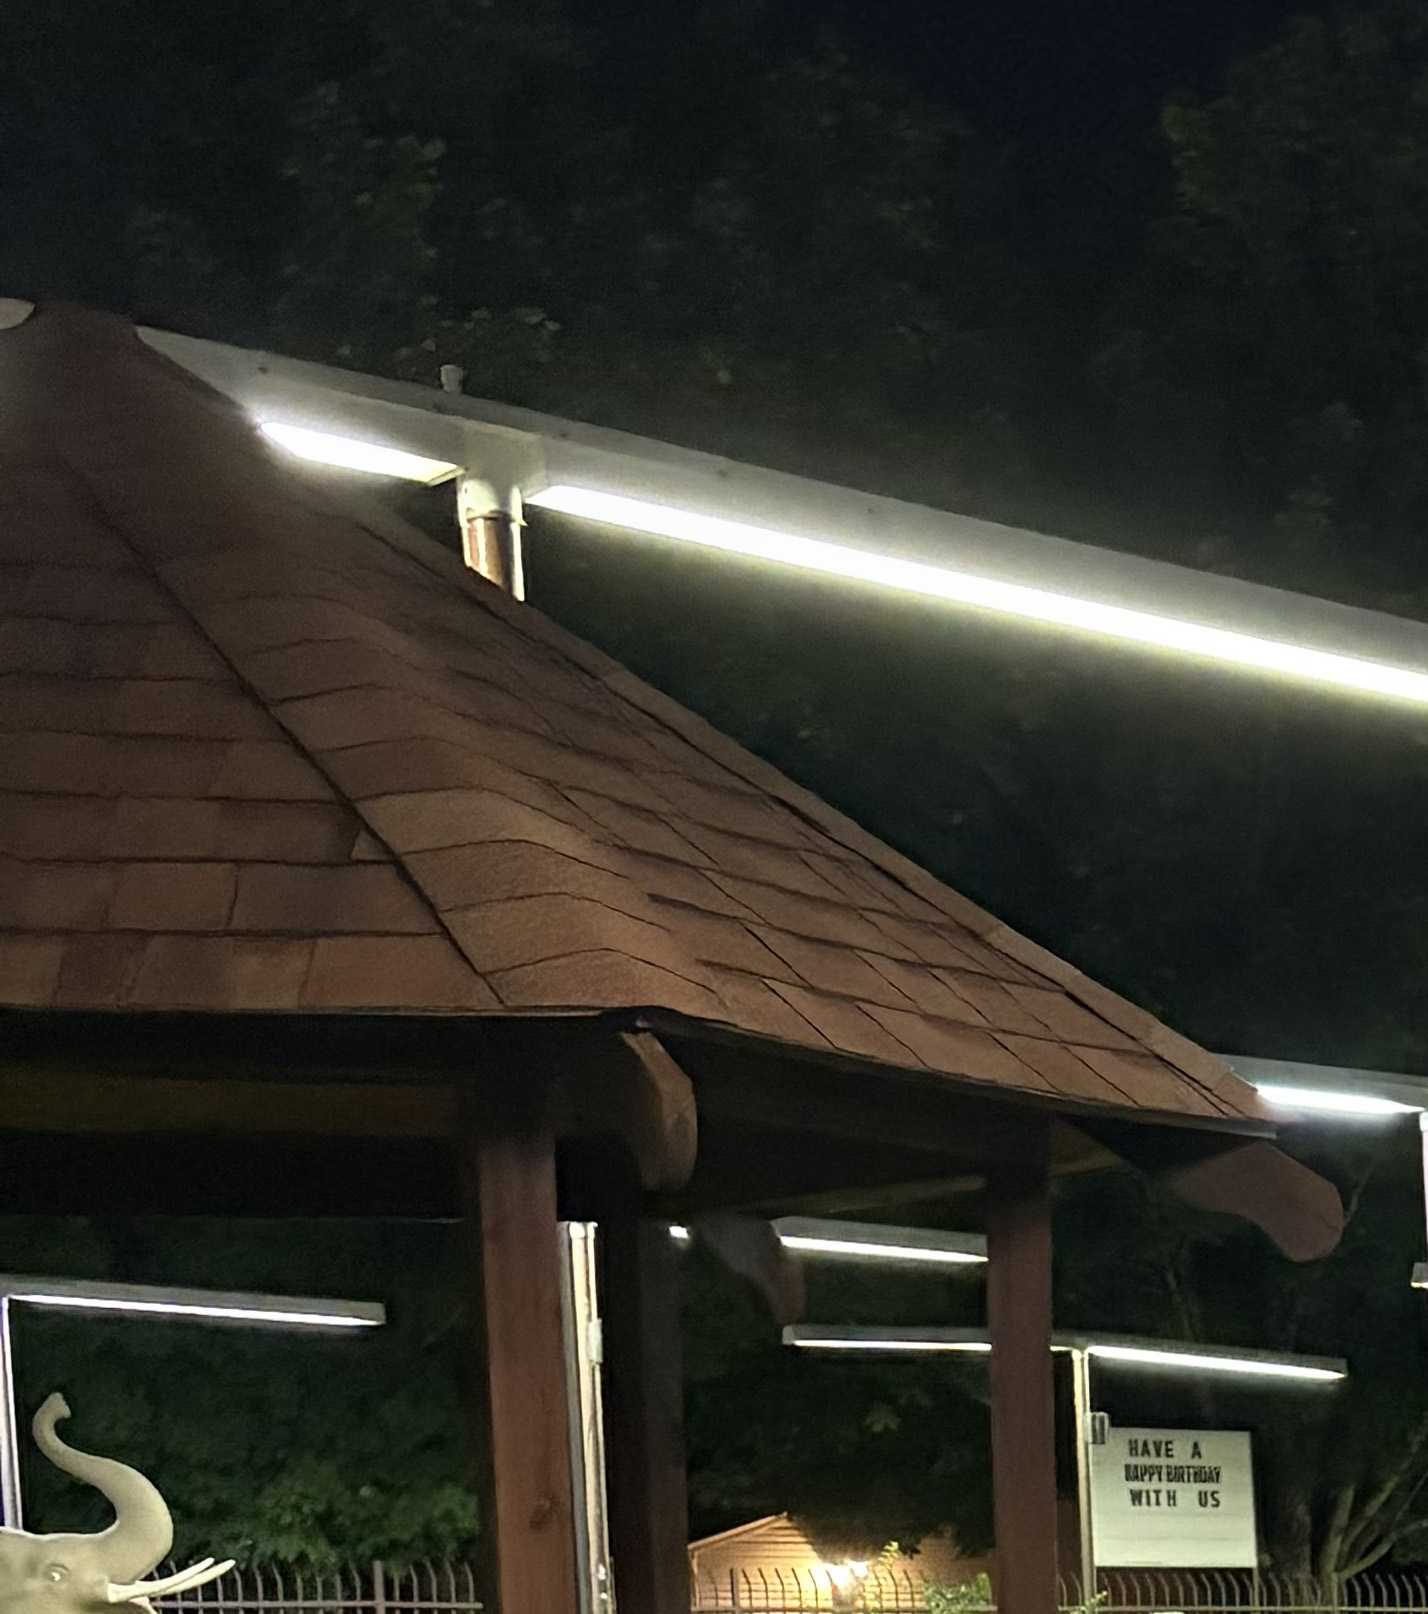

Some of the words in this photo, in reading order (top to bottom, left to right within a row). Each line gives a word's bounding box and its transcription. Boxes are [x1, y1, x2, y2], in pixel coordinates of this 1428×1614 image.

[1128, 1439, 1175, 1459] HAVE
[1191, 1441, 1202, 1459] A
[1124, 1464, 1163, 1482] HAPPY
[1166, 1465, 1221, 1484] BIRTHDAY
[1129, 1489, 1177, 1507] WITH
[1198, 1490, 1221, 1508] US
